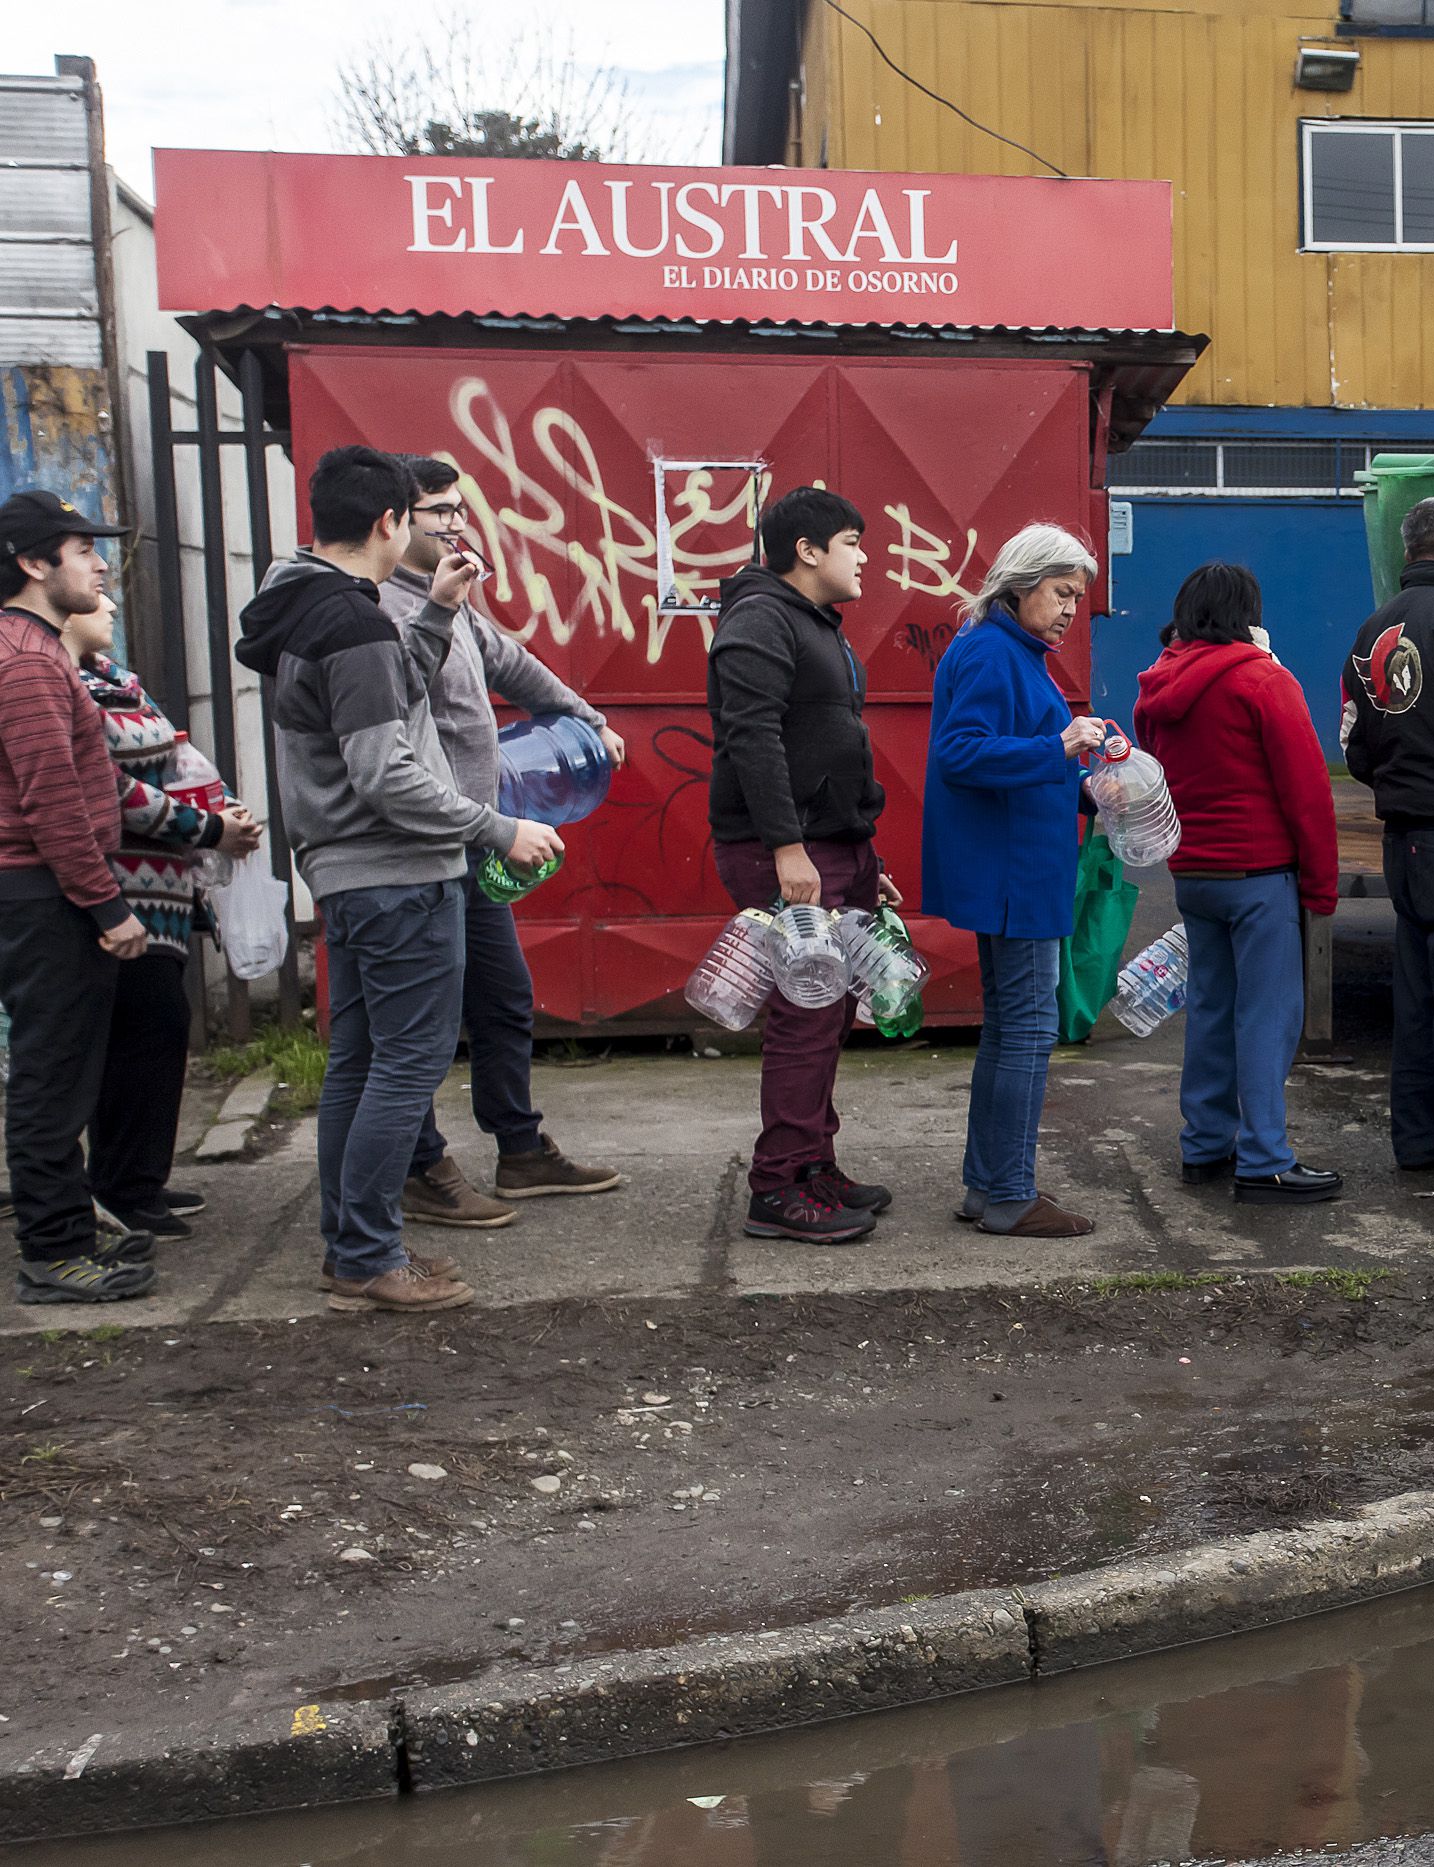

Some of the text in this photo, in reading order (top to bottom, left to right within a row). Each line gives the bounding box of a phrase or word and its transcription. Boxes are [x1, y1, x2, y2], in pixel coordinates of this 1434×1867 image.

[403, 175, 958, 263] EL AUSTRAL
[663, 266, 959, 295] EL DIARIO DE OSORNO
